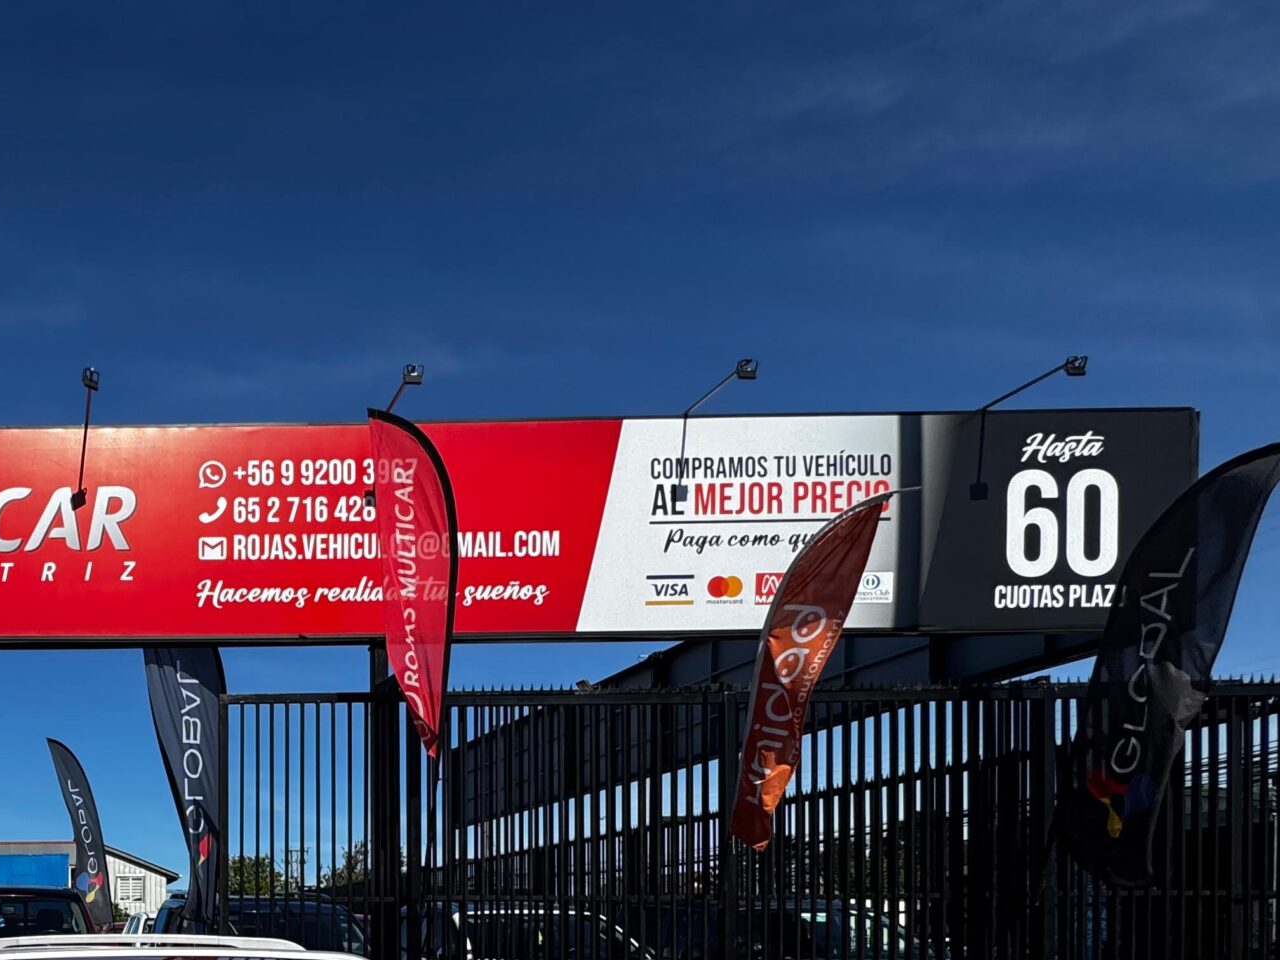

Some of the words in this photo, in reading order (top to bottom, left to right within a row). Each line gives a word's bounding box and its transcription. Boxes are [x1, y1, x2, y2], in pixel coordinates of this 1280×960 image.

[1021, 430, 1105, 463] Hasta
[233, 459, 274, 486] +56
[281, 459, 294, 486] 9
[300, 459, 356, 485] 9200
[650, 456, 768, 479] COMPRAMOS
[773, 455, 797, 477] TU
[803, 450, 892, 478] VEHÍCULO
[233, 497, 260, 523] 65
[267, 497, 280, 522] 2
[287, 497, 328, 522] 716
[651, 484, 685, 516] AL
[694, 481, 783, 515] MEJOR
[393, 467, 417, 598] MULTICAR
[1006, 468, 1119, 577] 60
[664, 528, 725, 554] Paga
[728, 534, 785, 547] como
[196, 579, 311, 608] Hacemos
[462, 581, 550, 607] sueños
[651, 583, 689, 597] VISA
[994, 585, 1065, 608] CUOTAS
